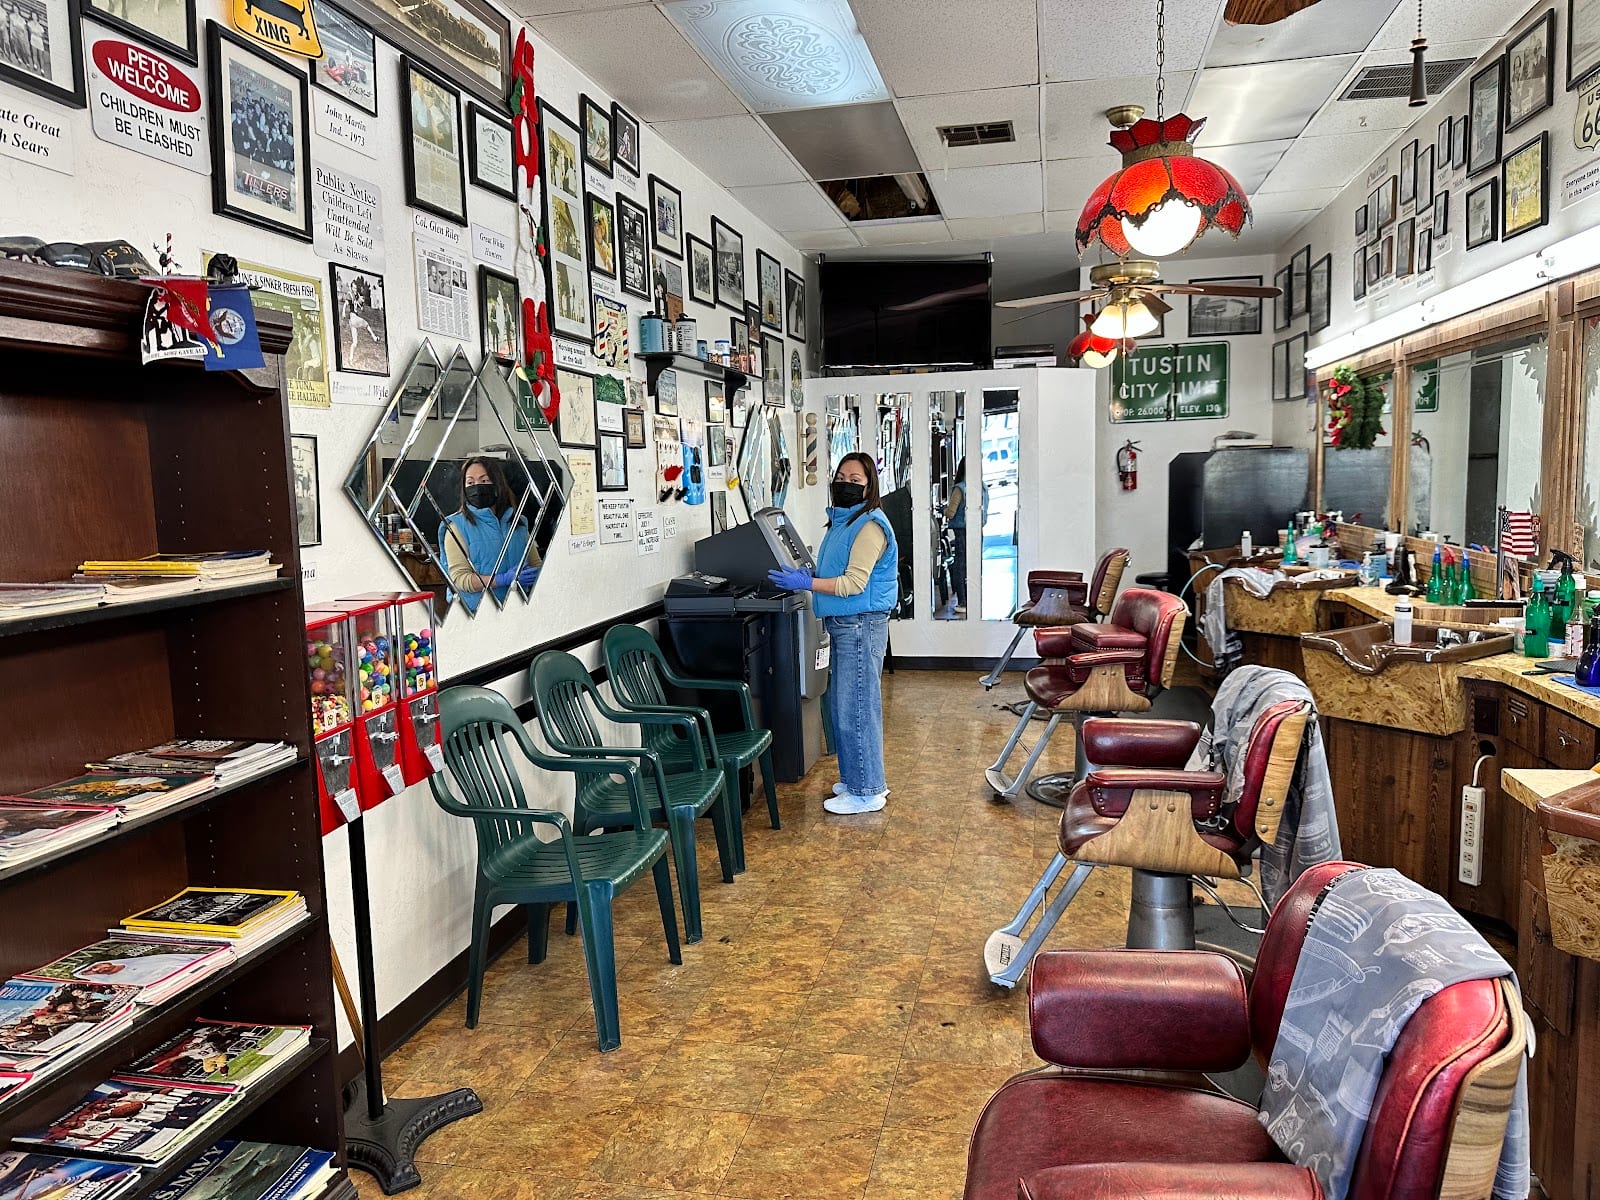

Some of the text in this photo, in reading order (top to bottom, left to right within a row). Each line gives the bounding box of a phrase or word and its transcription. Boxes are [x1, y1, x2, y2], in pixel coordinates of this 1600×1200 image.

[254, 14, 291, 45] XING
[127, 46, 169, 81] PETS
[107, 57, 190, 109] WELCOME
[23, 114, 60, 138] Great
[100, 92, 201, 142] CHILDREN MUST
[325, 104, 367, 132] John Martin
[12, 133, 49, 157] Sears
[115, 117, 193, 157] BE LEASHED
[329, 123, 343, 137] Ind.
[350, 131, 365, 147] 1973
[242, 171, 289, 200] TILLERS
[316, 168, 377, 206] Public Notice
[322, 190, 372, 221] Children Left
[327, 207, 370, 234] Unattended
[415, 214, 460, 244] Col. Glen Riley
[325, 223, 373, 250] Will Be Sold
[333, 241, 369, 263] As Slaves
[260, 276, 282, 293] SINKER
[283, 282, 301, 296] FRESH
[301, 286, 314, 298] FISH
[1129, 354, 1211, 376] TUSTIN
[1119, 382, 1159, 400] CITY
[1180, 405, 1201, 414] ELEV.
[170, 1145, 224, 1188] NAVY
